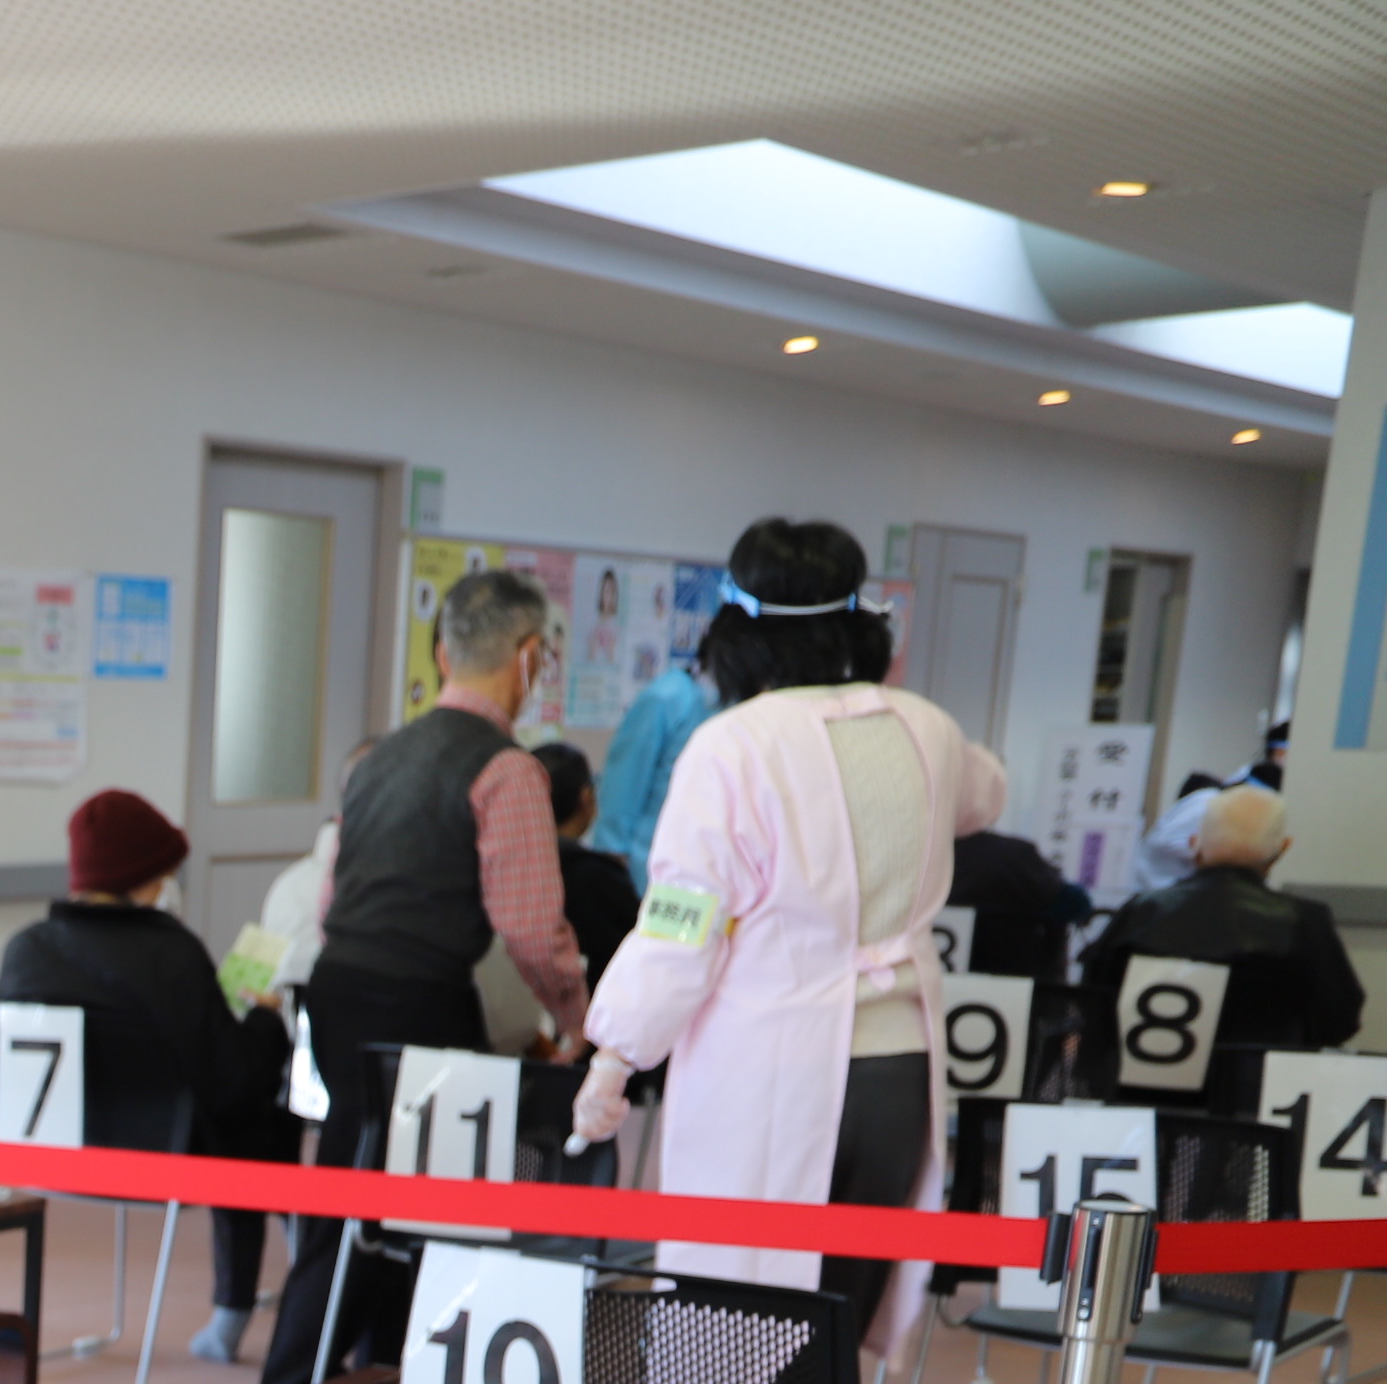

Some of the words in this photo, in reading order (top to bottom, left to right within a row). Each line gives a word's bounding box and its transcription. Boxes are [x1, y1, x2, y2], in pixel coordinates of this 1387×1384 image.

[1090, 739, 1129, 810] 受付
[946, 1003, 1009, 1092] 9
[1125, 983, 1202, 1065] 8
[10, 1040, 63, 1138] 7
[401, 1094, 491, 1180] 11
[1271, 1091, 1387, 1198] 14
